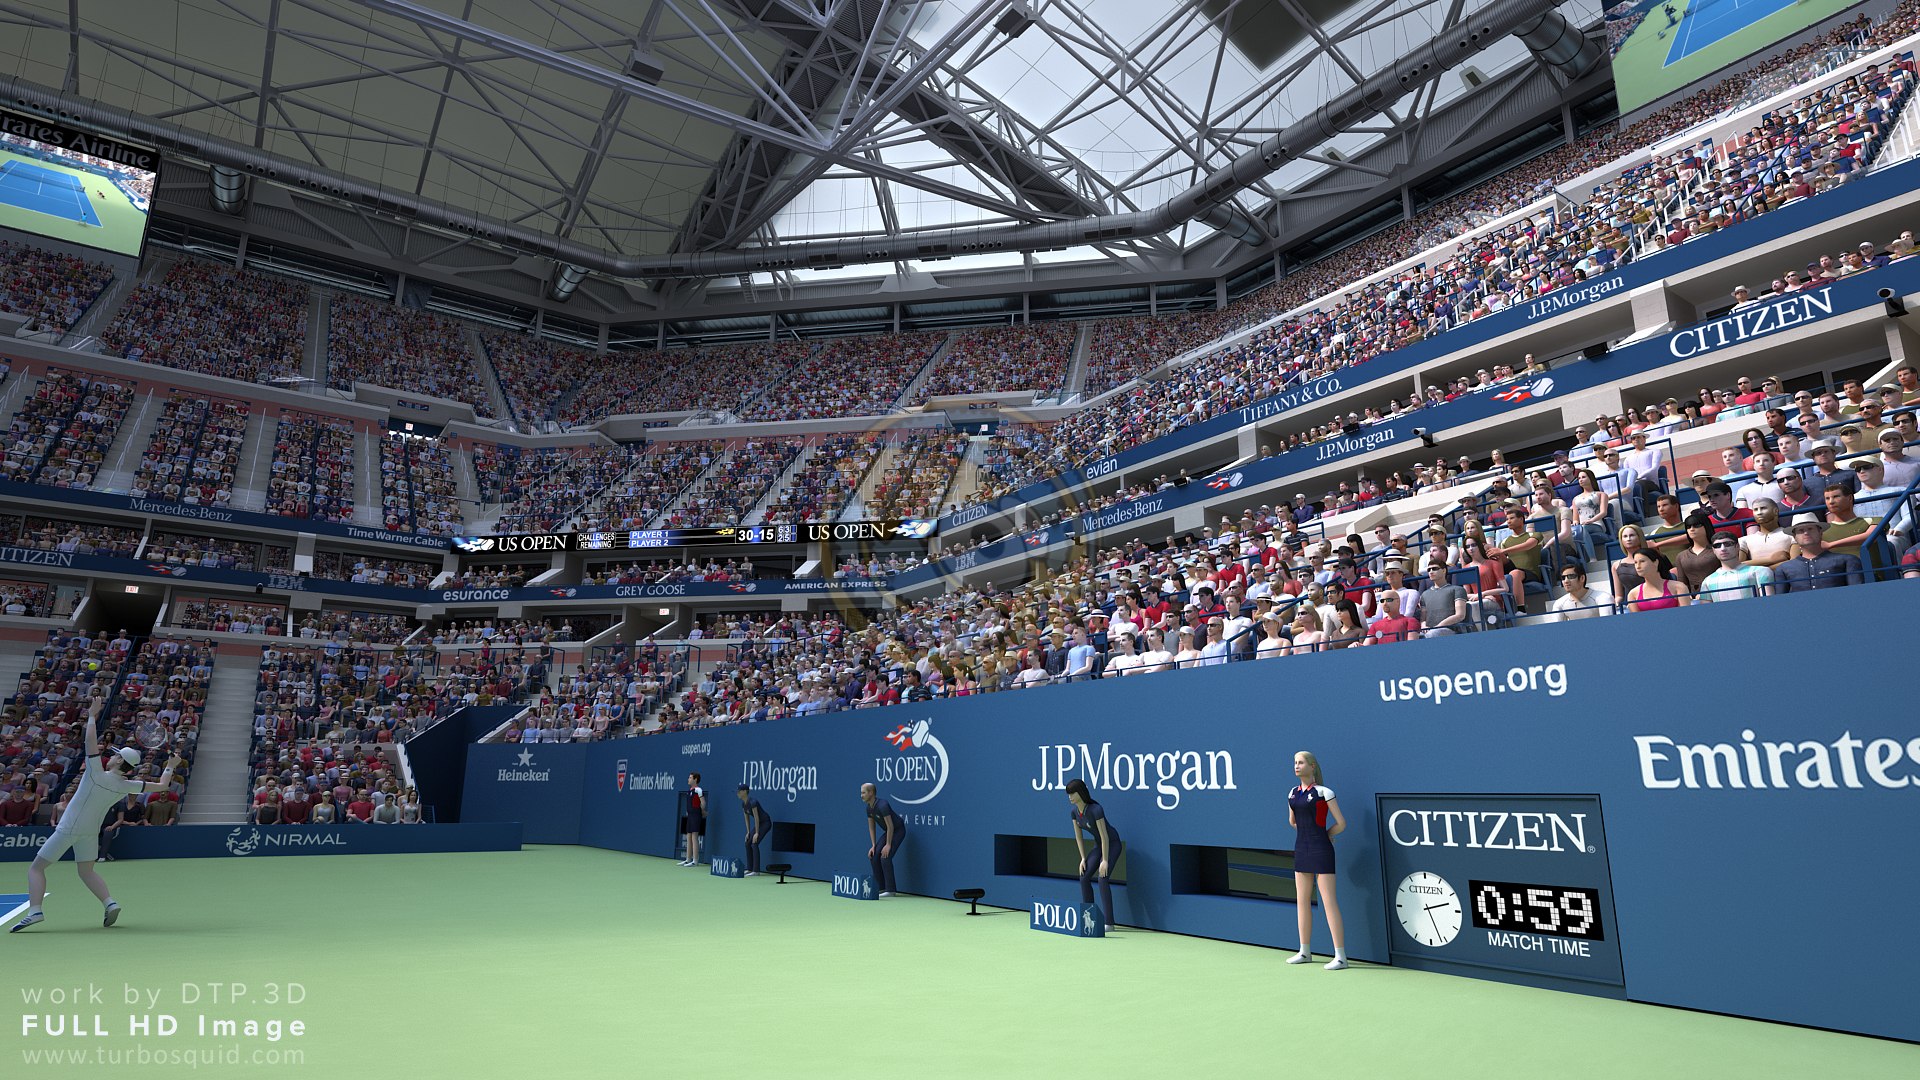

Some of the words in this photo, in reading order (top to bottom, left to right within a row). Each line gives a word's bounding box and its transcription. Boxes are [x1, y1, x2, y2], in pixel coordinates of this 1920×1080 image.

[0, 113, 64, 144] rates
[69, 133, 151, 169] Airline
[1527, 276, 1625, 320] J.P.Morgan
[1669, 286, 1833, 358] CITIZEN
[1239, 392, 1300, 424] TIFFANY
[1301, 387, 1313, 403] &
[1316, 428, 1395, 461] J.P.Morgan
[1086, 457, 1118, 480] evian
[129, 498, 233, 522] Mercedes-Benz
[952, 504, 988, 527] CITIZEN
[1081, 499, 1163, 533] Mercedes-Benz
[347, 527, 375, 539] Time
[375, 531, 414, 544] Warner
[578, 532, 615, 541] CHALLENGES
[632, 531, 663, 539] PLAYER
[738, 528, 774, 541] 30-15
[808, 525, 830, 541] US
[833, 522, 886, 540] OPEN
[498, 536, 517, 552] US
[520, 535, 567, 551] OPEN
[955, 552, 976, 572] IBM
[267, 574, 305, 591] IBM
[616, 585, 645, 597] GREY
[647, 584, 685, 595] GOOSE
[784, 582, 838, 590] AMERICAN
[841, 580, 887, 589] EXPRESS
[442, 589, 509, 601] esurance
[1379, 663, 1568, 704] usopen.org
[681, 742, 711, 757] usopen.org
[497, 768, 550, 782] Heineken
[875, 757, 893, 782] US
[895, 755, 938, 782] OPEN
[1031, 742, 1238, 811] J.PMorgan
[629, 773, 653, 790] Emirates
[654, 771, 675, 790] Airline
[738, 760, 818, 803] JP.Morgan
[914, 814, 946, 826] EVENT
[264, 833, 347, 846] NIRMAL
[712, 858, 729, 875] POLO
[834, 875, 859, 896] POLO
[1408, 885, 1443, 895] CITIZEN
[1033, 902, 1078, 931] POLO
[1476, 885, 1594, 935] 0:59
[1487, 931, 1544, 952] MATCH
[1548, 938, 1591, 958] TIME
